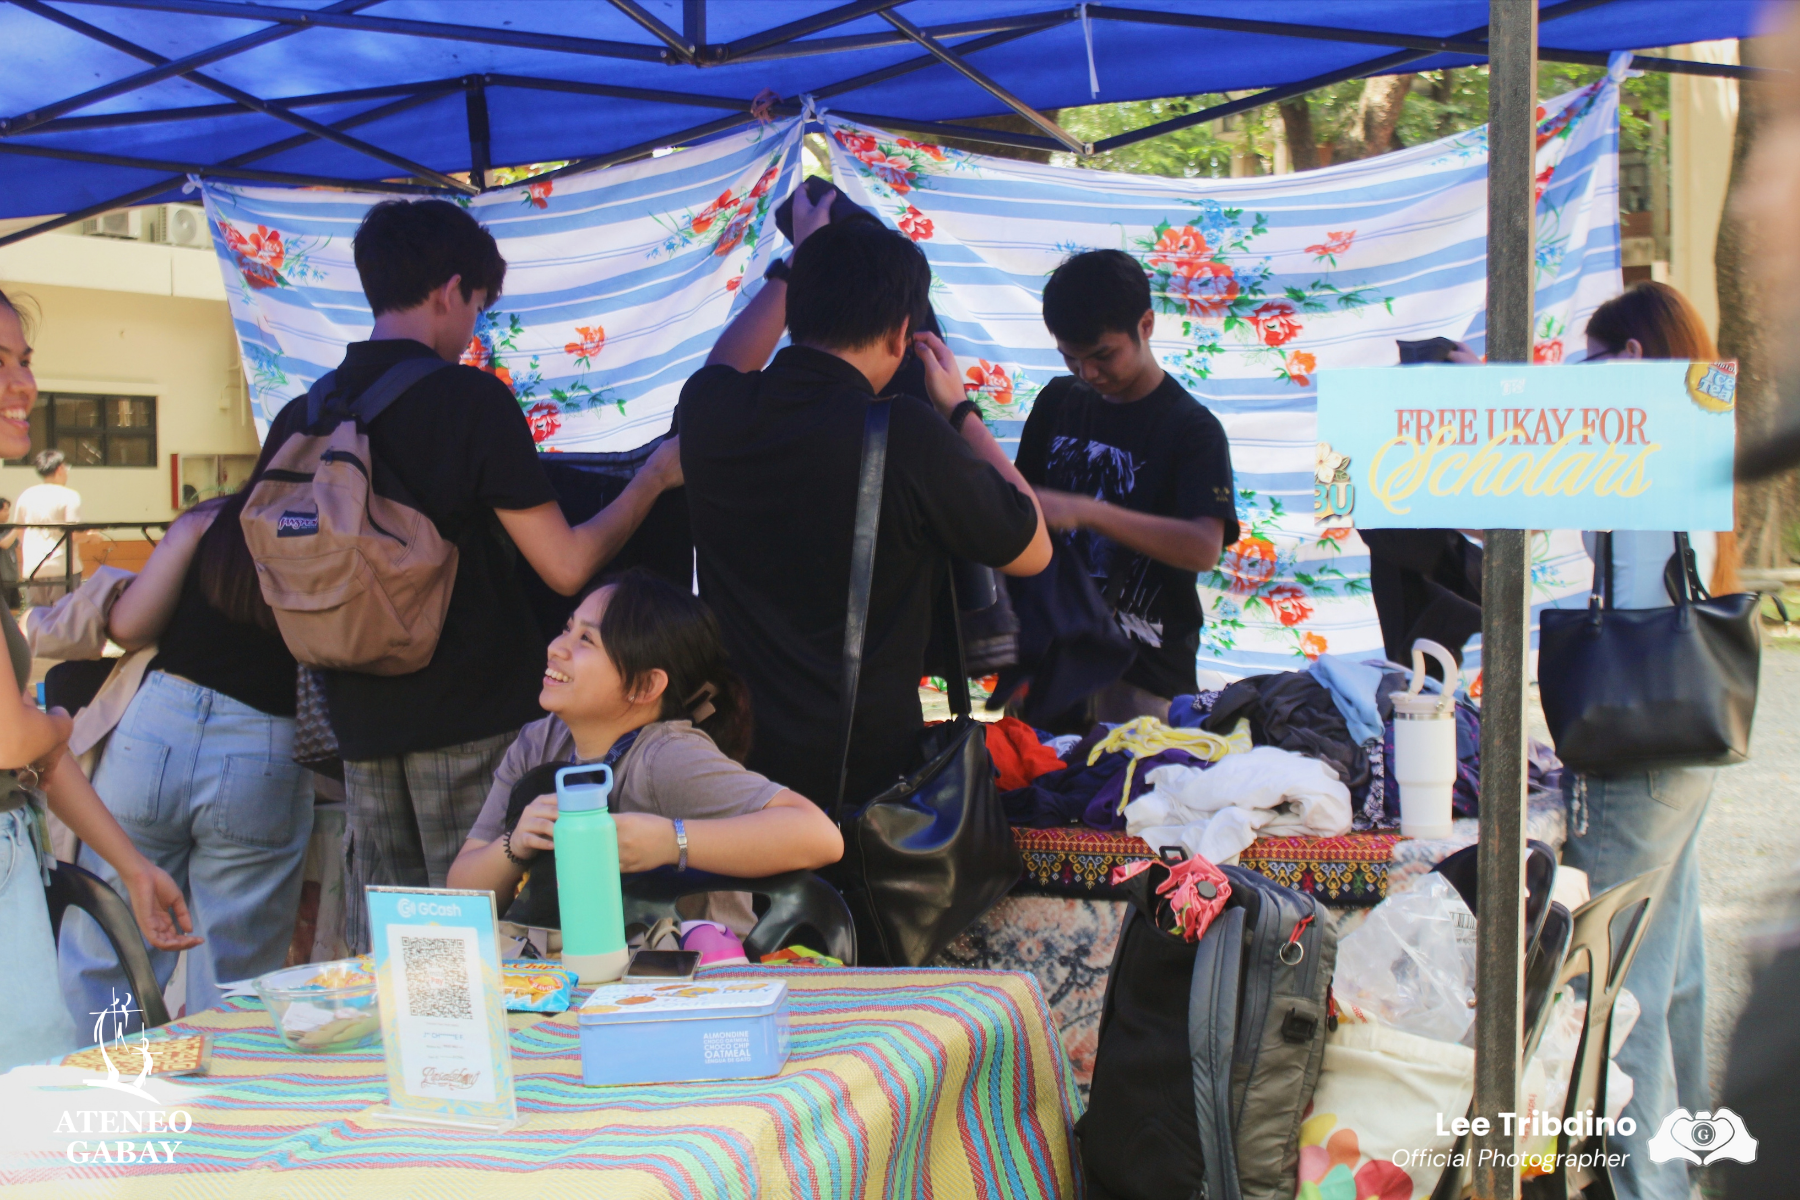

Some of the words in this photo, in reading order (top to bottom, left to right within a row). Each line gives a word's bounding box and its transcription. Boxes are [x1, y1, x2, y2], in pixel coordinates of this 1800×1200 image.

[1702, 367, 1736, 391] Ice
[1698, 380, 1734, 404] Tea
[1394, 408, 1477, 446] FREE
[1485, 408, 1575, 446] UKAY
[1582, 407, 1651, 446] FOR
[1368, 425, 1662, 515] Scholars
[418, 902, 462, 917] GCash
[703, 1030, 749, 1040] ALMONDINE
[704, 1043, 732, 1051] CHOCO
[704, 1048, 751, 1059] OATMEAL
